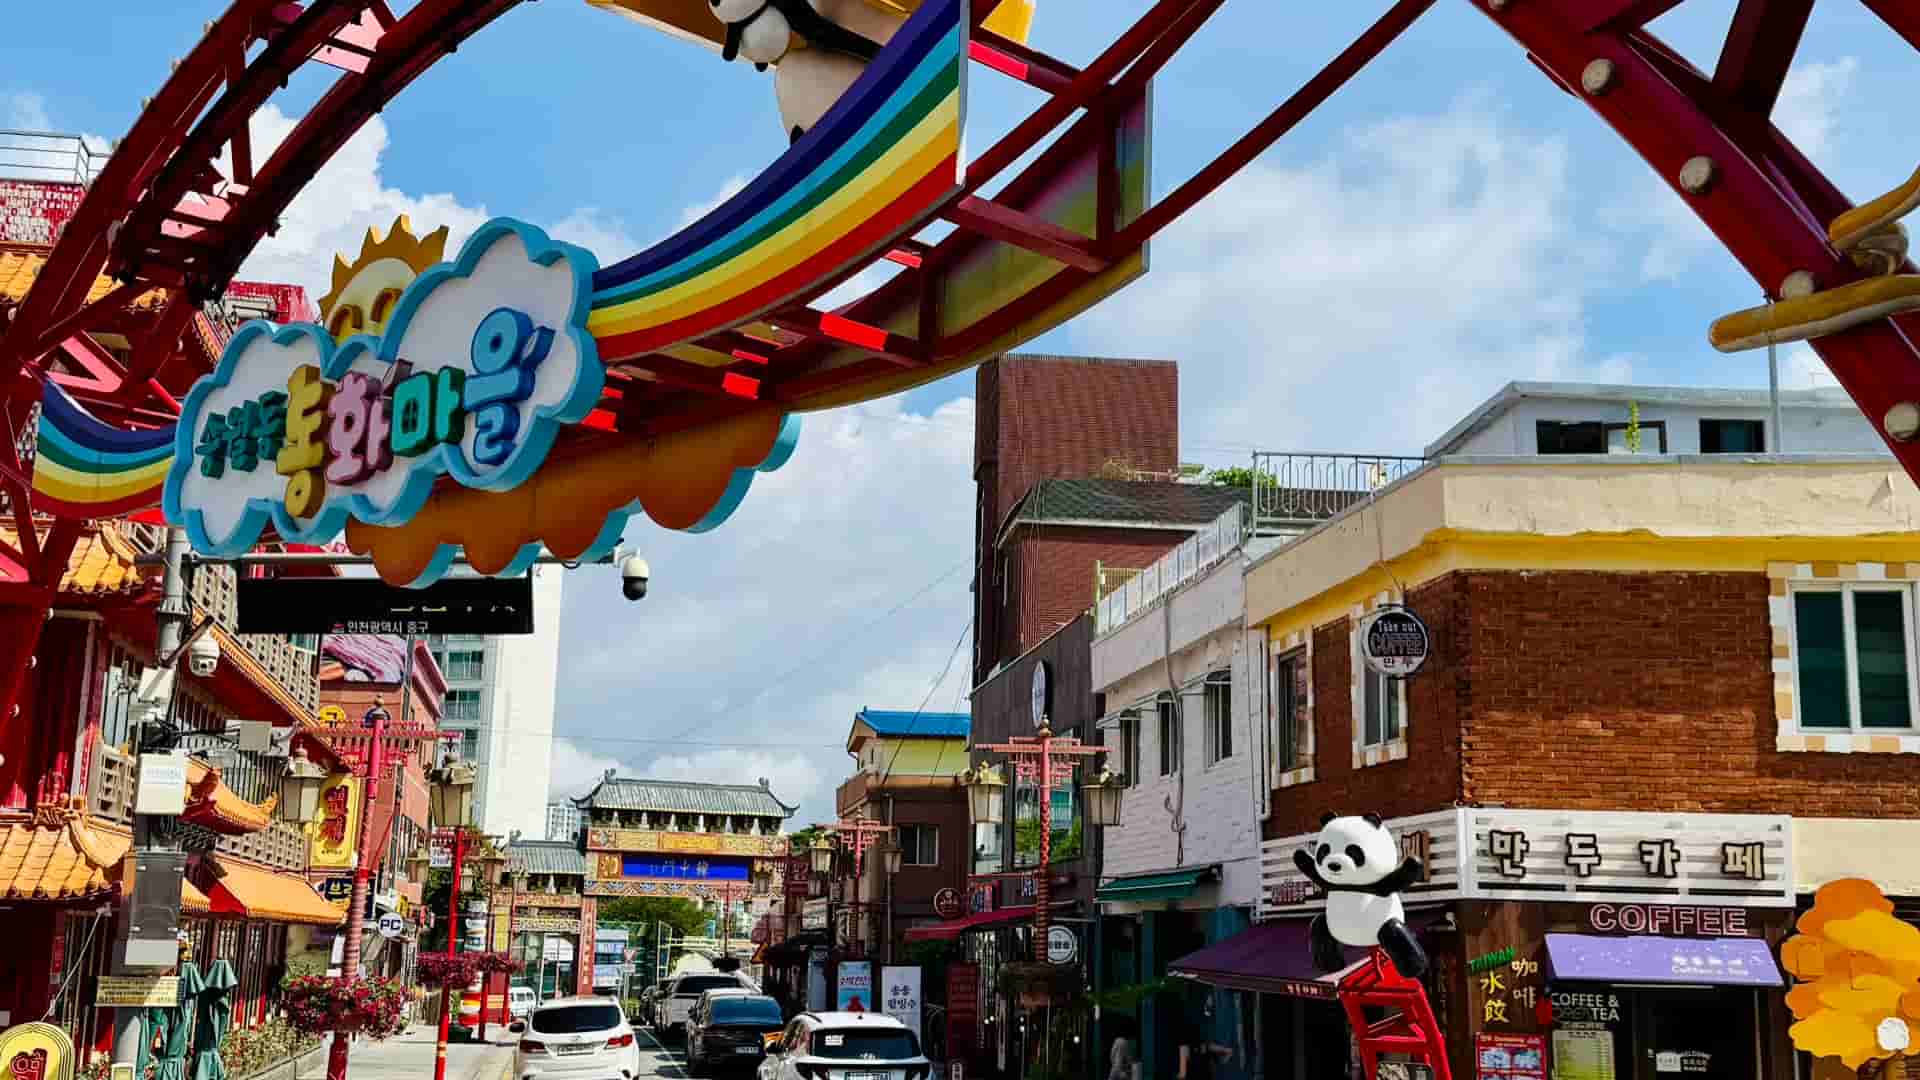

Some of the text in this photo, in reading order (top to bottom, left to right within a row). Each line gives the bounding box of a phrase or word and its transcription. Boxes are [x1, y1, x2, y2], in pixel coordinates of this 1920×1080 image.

[195, 307, 556, 519] 송월동 동화마을
[346, 620, 429, 633] 인천광역시 중구
[1370, 633, 1423, 654] COFFEE
[379, 918, 402, 932] PC
[1590, 903, 1749, 936] COFFEE
[1470, 944, 1516, 973] TAIWAN
[1479, 970, 1511, 1023] 水餃
[1551, 992, 1620, 1007] COFFEE &
[1591, 1007, 1621, 1021] TEA
